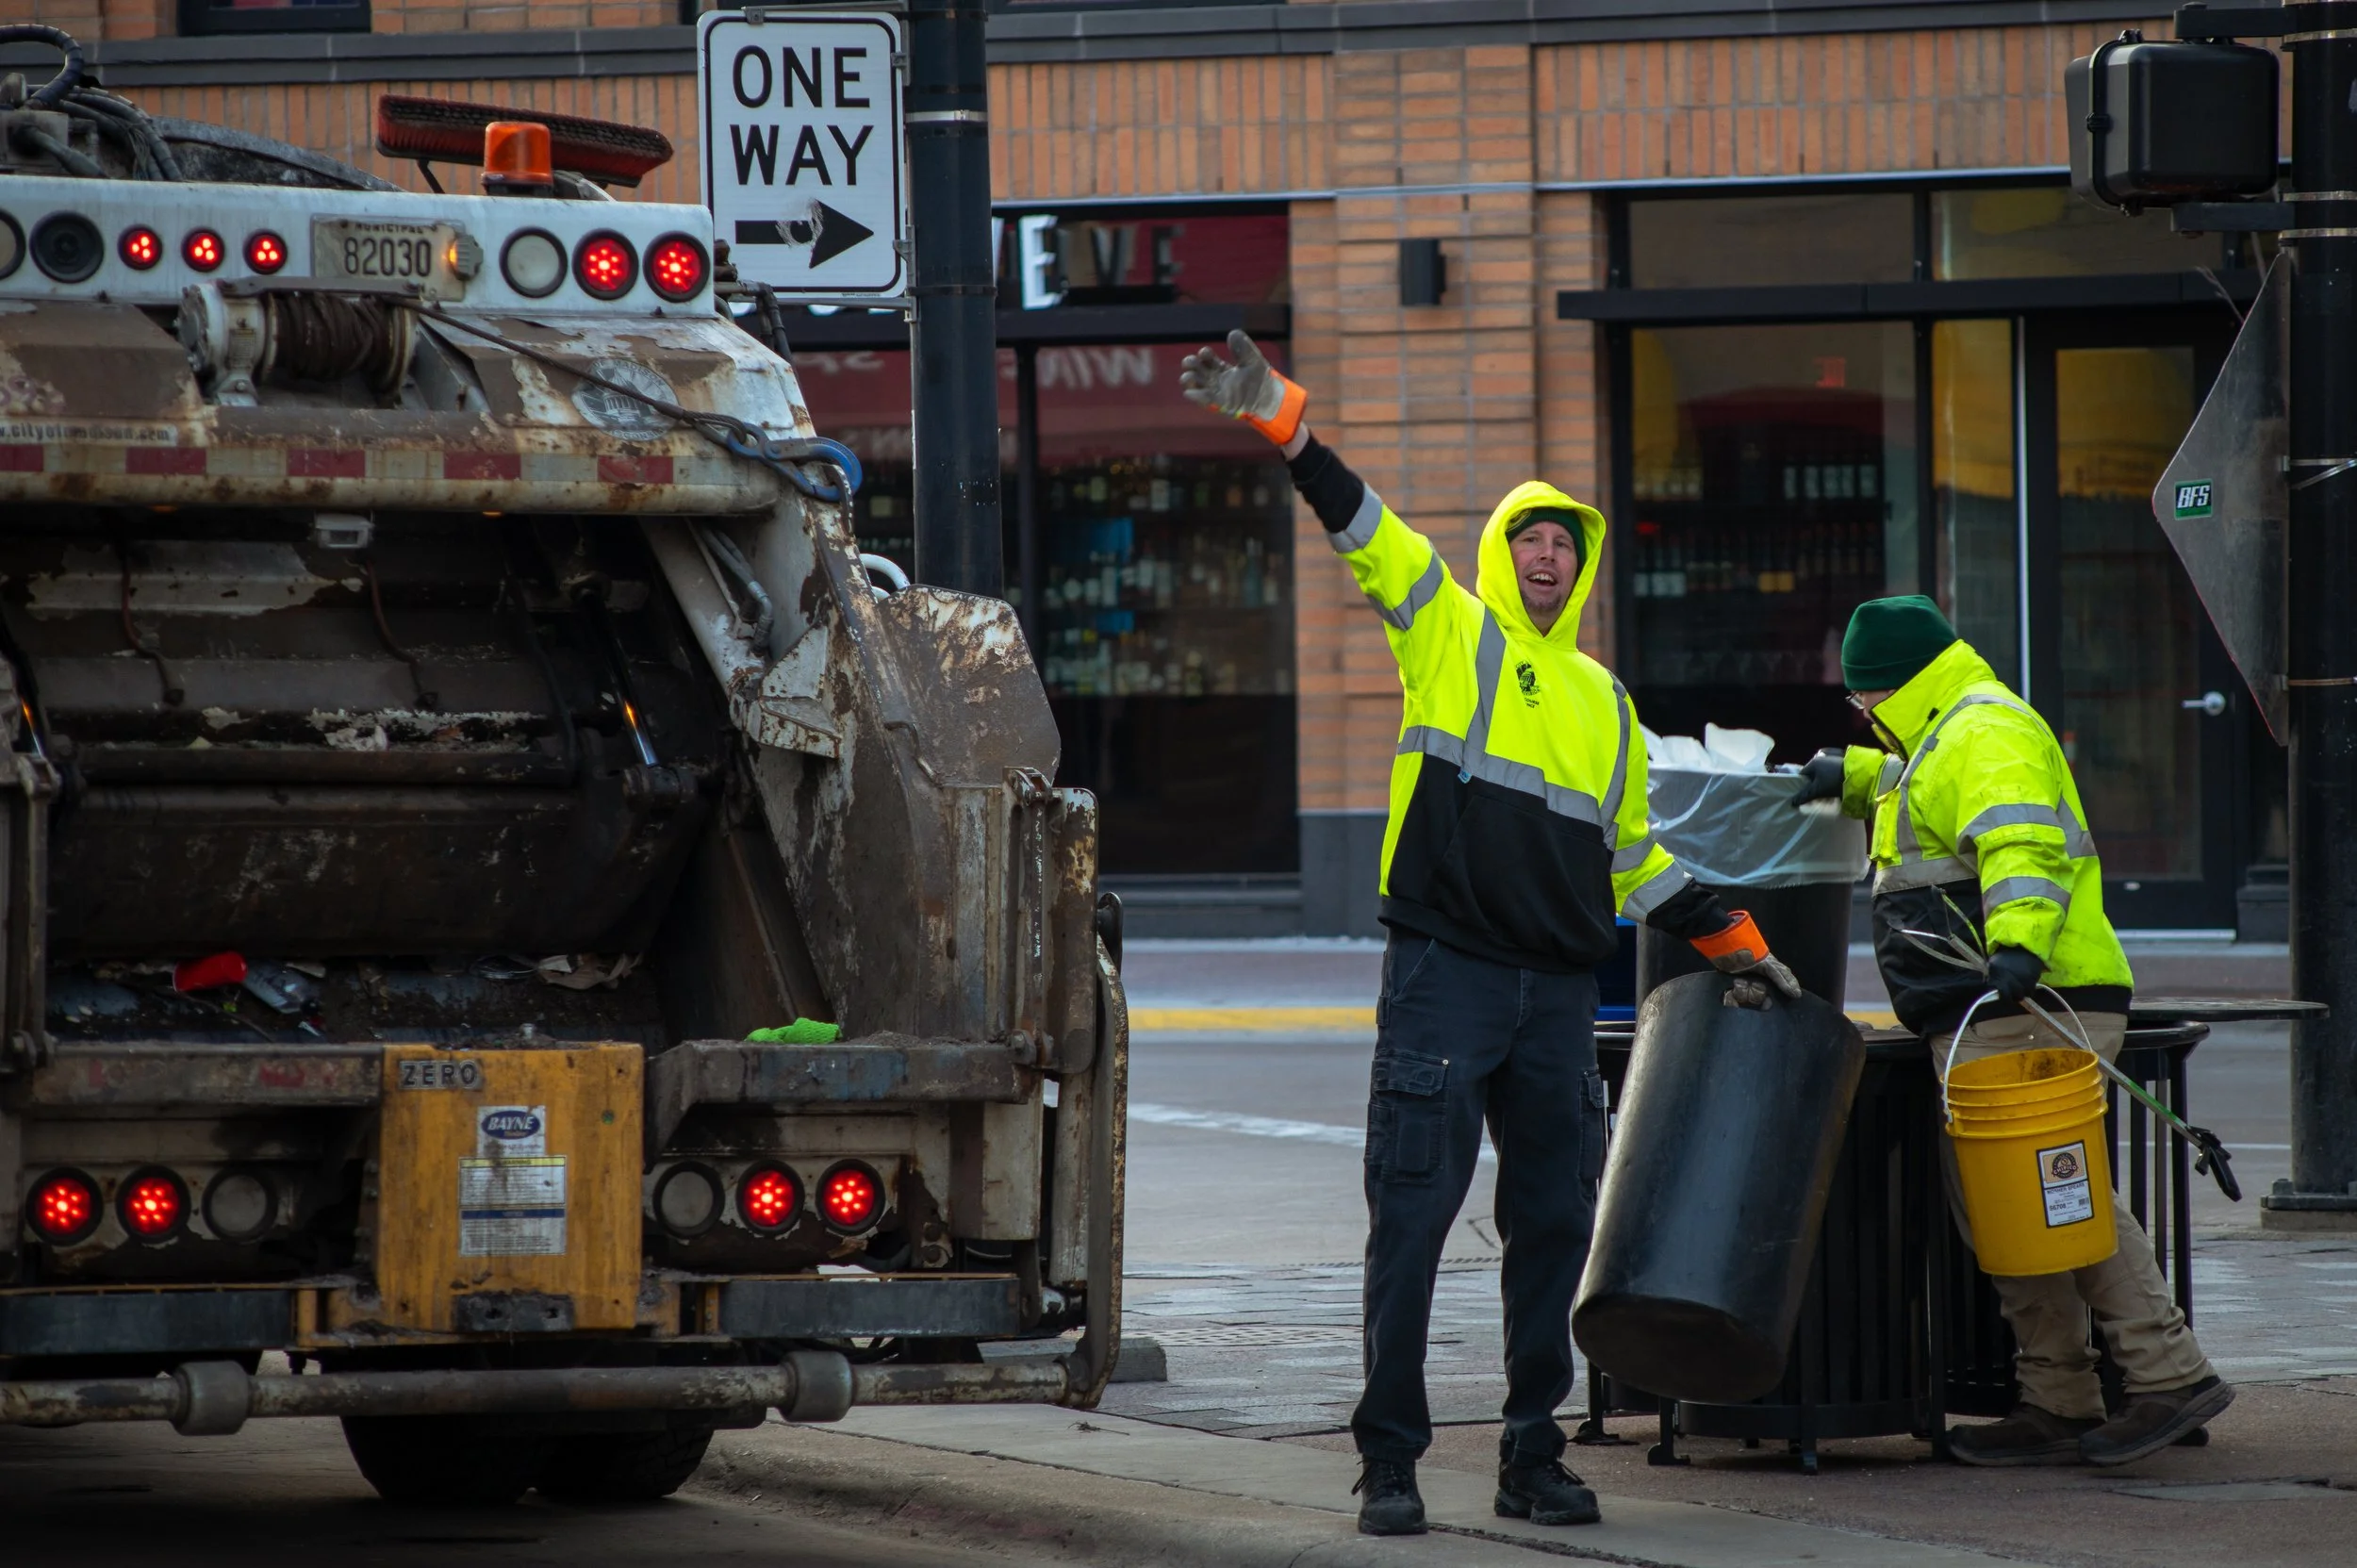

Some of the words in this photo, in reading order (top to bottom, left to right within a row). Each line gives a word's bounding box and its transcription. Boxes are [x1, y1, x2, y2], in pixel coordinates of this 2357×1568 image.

[733, 45, 870, 108] ONE
[730, 124, 874, 186] WAY
[344, 237, 432, 277] 82030
[2178, 485, 2210, 508] BFS
[403, 1064, 476, 1085] ZERO
[487, 1115, 535, 1131] BAYNE
